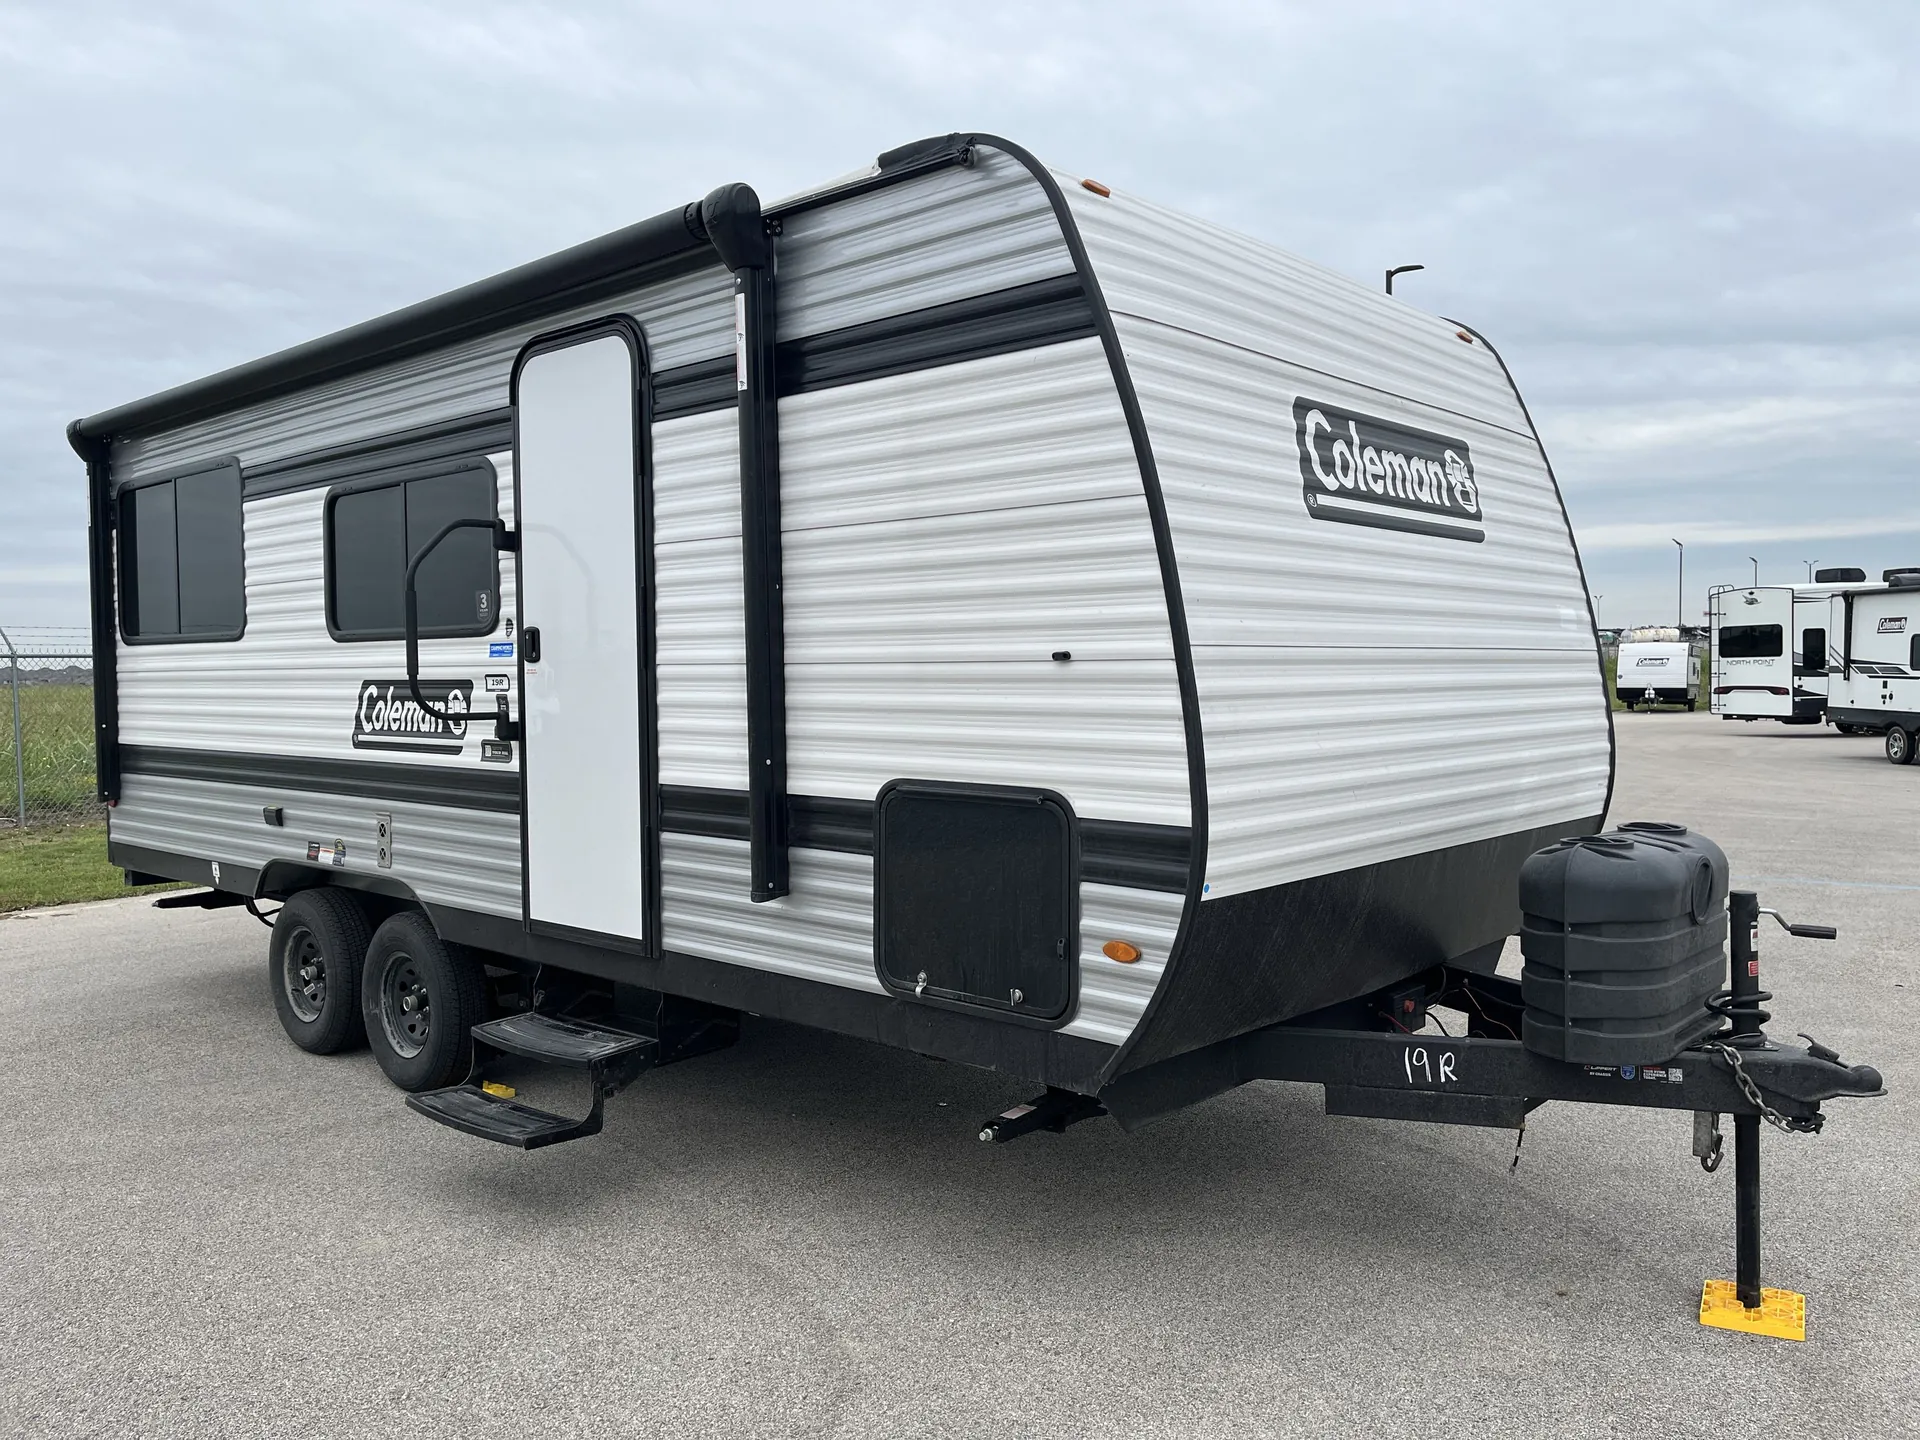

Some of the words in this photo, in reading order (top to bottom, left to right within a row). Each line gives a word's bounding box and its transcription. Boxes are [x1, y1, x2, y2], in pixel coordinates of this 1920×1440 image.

[1305, 409, 1451, 507] Coleman
[480, 593, 487, 609] 3
[1879, 618, 1901, 630] Coleman
